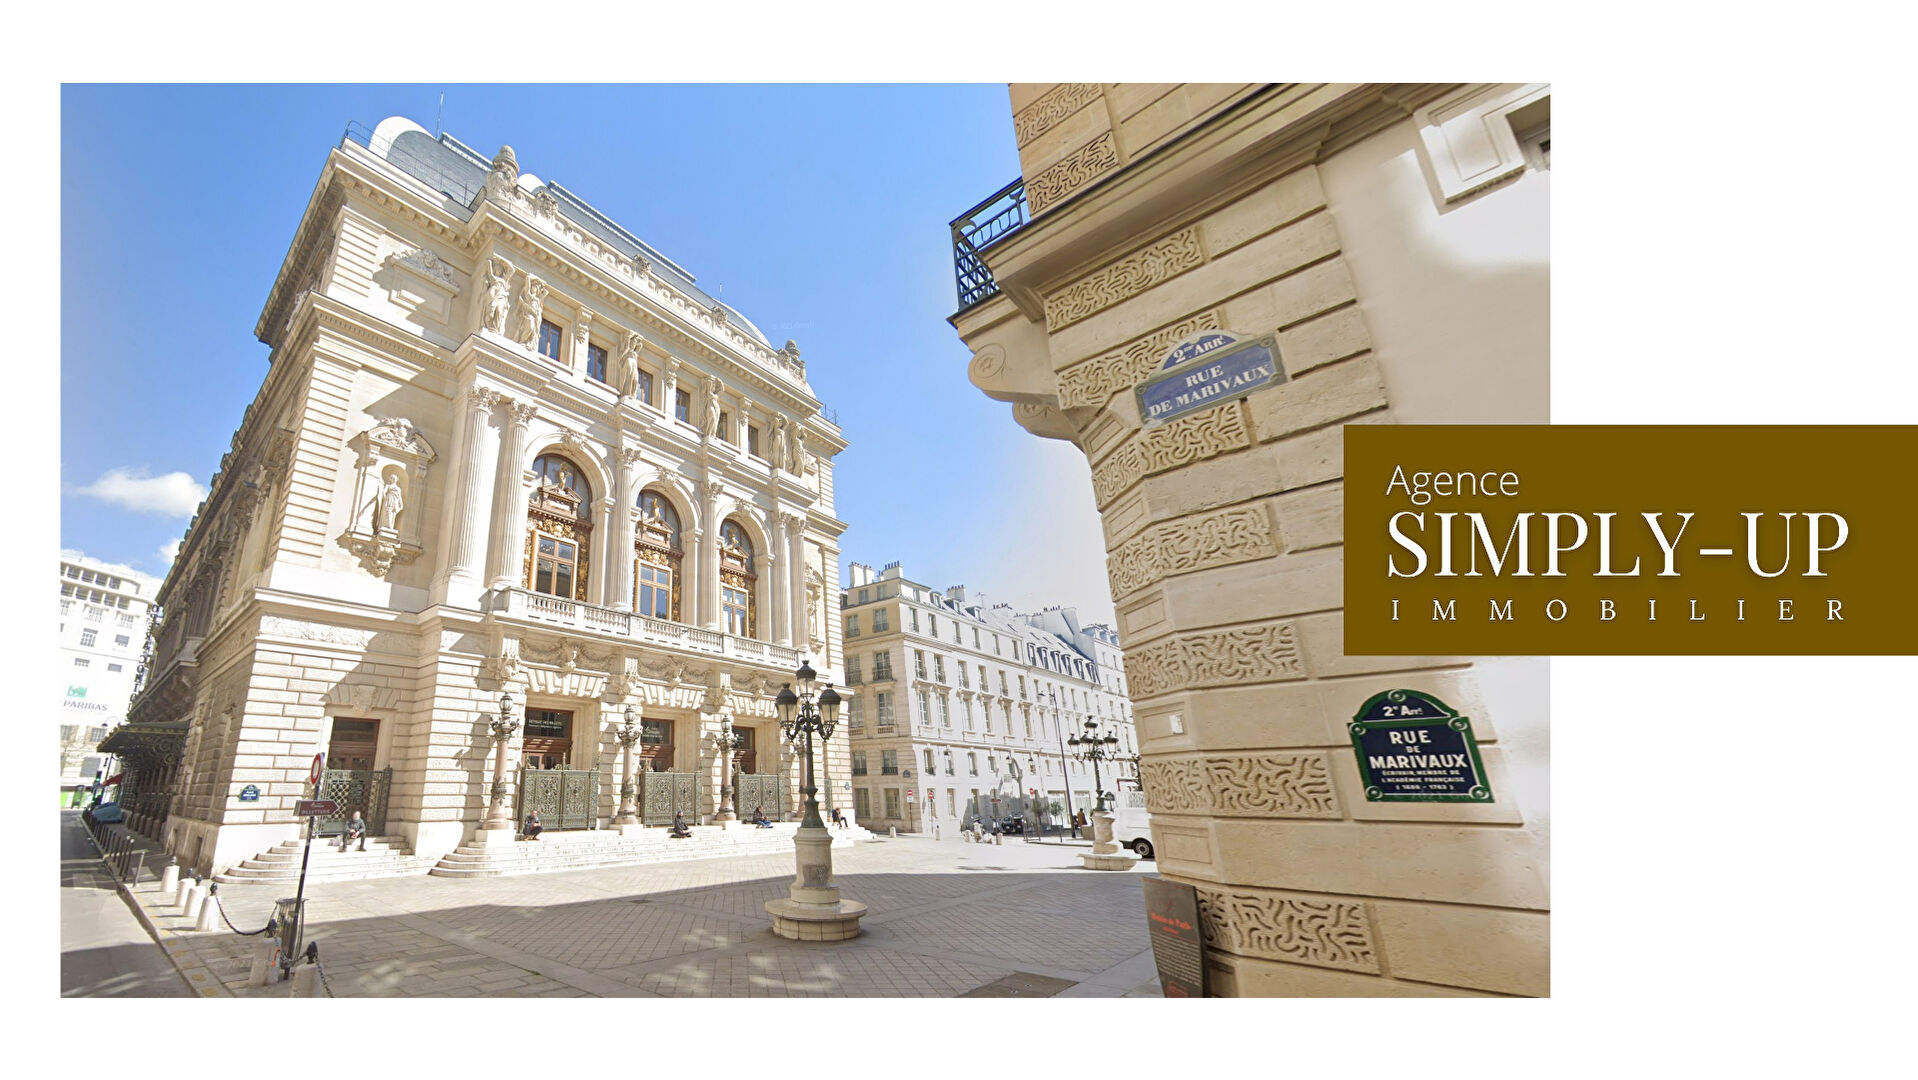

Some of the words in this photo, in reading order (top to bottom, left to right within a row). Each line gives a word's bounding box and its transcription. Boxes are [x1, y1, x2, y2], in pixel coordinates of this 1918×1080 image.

[1185, 364, 1224, 388] RUE
[1149, 400, 1173, 417] DE
[1175, 363, 1270, 408] MARIVAUX
[63, 699, 108, 712] PARIBAS
[1389, 730, 1432, 744] RUE
[1369, 754, 1468, 769] MARIVAUX
